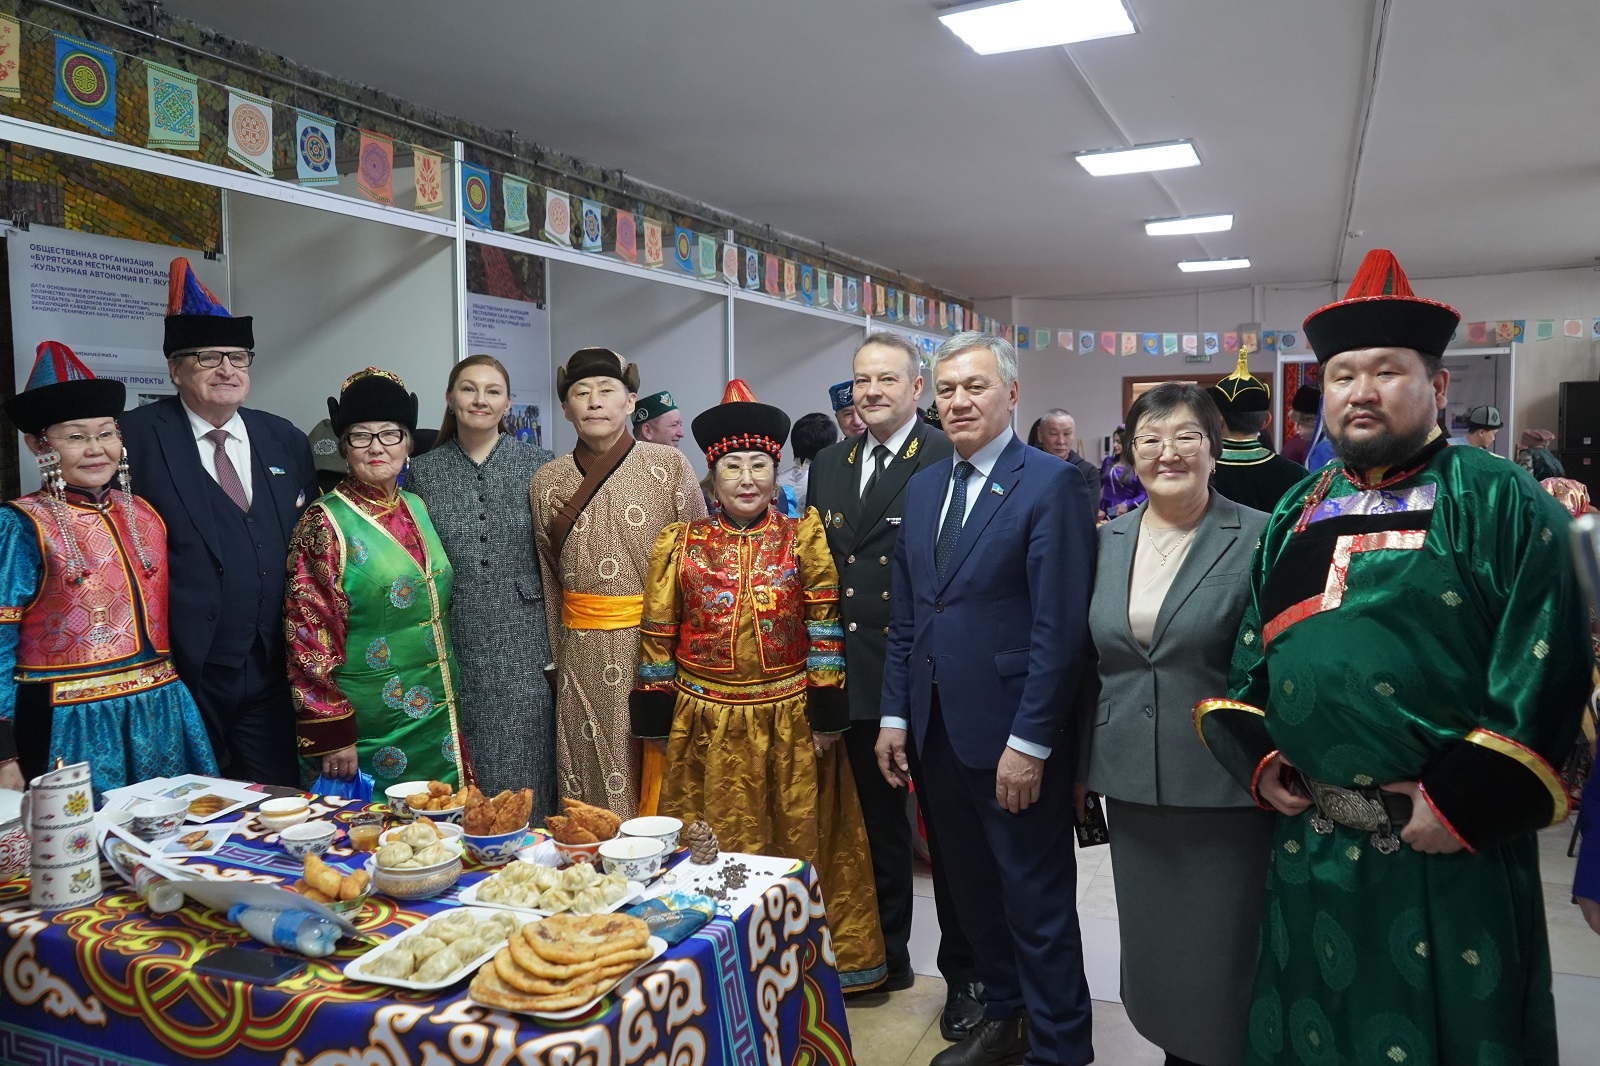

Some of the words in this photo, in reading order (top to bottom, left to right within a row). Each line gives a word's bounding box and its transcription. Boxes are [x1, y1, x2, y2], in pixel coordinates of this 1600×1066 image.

[30, 244, 97, 260] ОБЩЕСТВЕННАЯ
[100, 254, 154, 268] ОРГАНИЗАЦИЯ
[30, 254, 82, 266] «БУРЯТСКАЯ
[85, 261, 121, 271] МЕСТНАЯ
[123, 266, 170, 278] НАЦИОНАЛЬ
[31, 263, 87, 276] -КУЛЬТУРНАЯ
[90, 270, 136, 282] АВТОНОМИЯ
[31, 294, 70, 302] ПРЕДСЕДАТЕЛЬ
[87, 294, 121, 302] ОРГАНИЗАЦИИ
